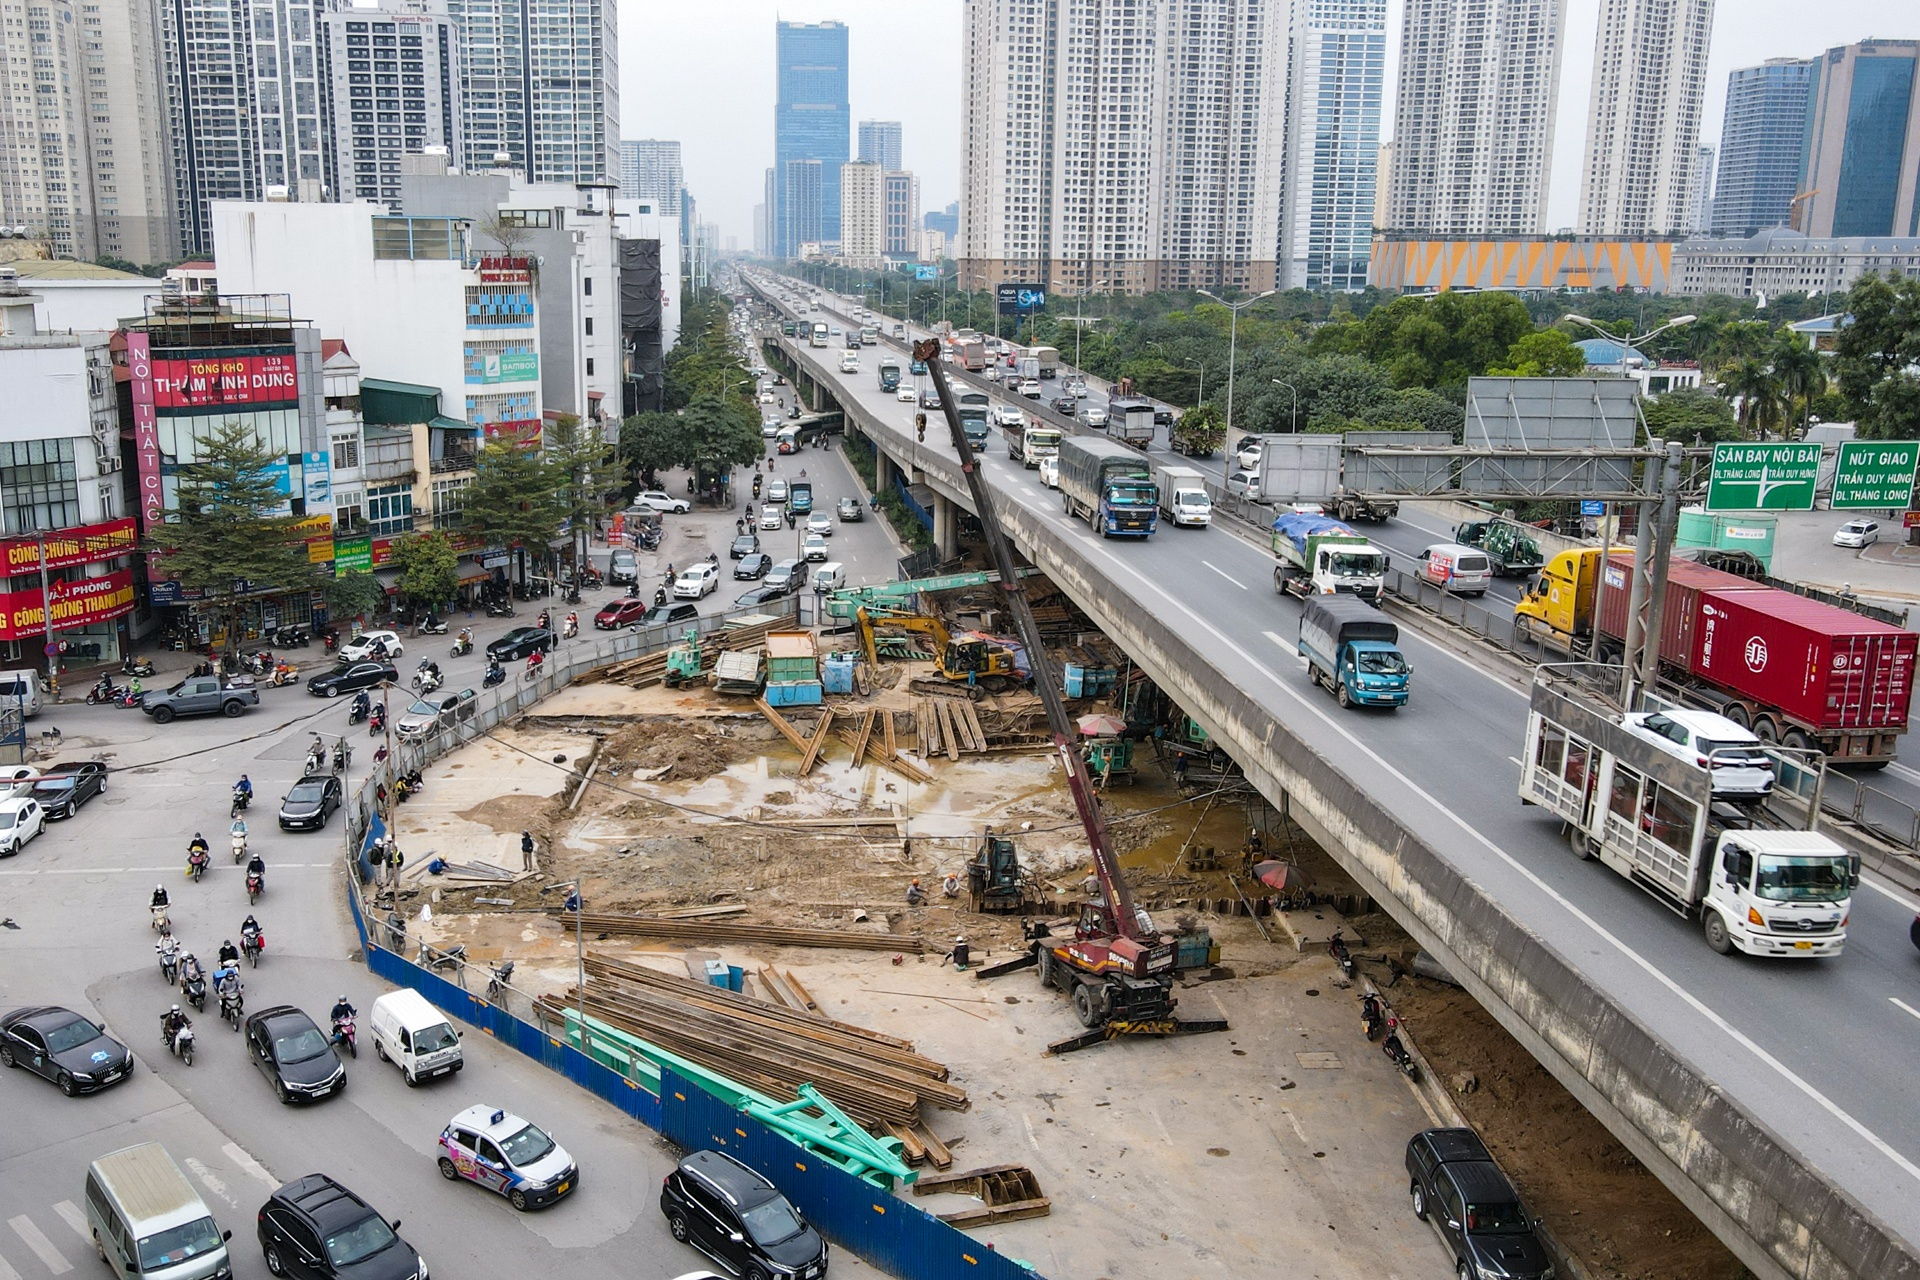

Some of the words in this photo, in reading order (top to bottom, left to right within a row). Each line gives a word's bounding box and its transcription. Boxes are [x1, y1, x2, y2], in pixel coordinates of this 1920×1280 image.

[134, 348, 149, 394] NỘI
[222, 362, 244, 373] KHO
[502, 362, 536, 371] BAMBOO
[252, 372, 294, 389] DUNG
[1716, 447, 1744, 463] SÂN
[1746, 449, 1770, 463] BAY
[1772, 446, 1795, 465] NỘI
[1797, 446, 1818, 463] BÀI
[1849, 449, 1875, 465] NÚT
[1879, 452, 1908, 465] GIAO
[1745, 469, 1761, 478] LONG
[1785, 469, 1799, 478] DUY
[1865, 473, 1885, 484] DUY
[1883, 490, 1908, 500] LONG
[8, 544, 40, 566] CÔNG
[72, 580, 112, 596] PHÒNG
[13, 607, 45, 628] CÔNG
[49, 599, 83, 621] HỨNG
[84, 592, 117, 610] THANH
[430, 1050, 449, 1060] SUZUKI
